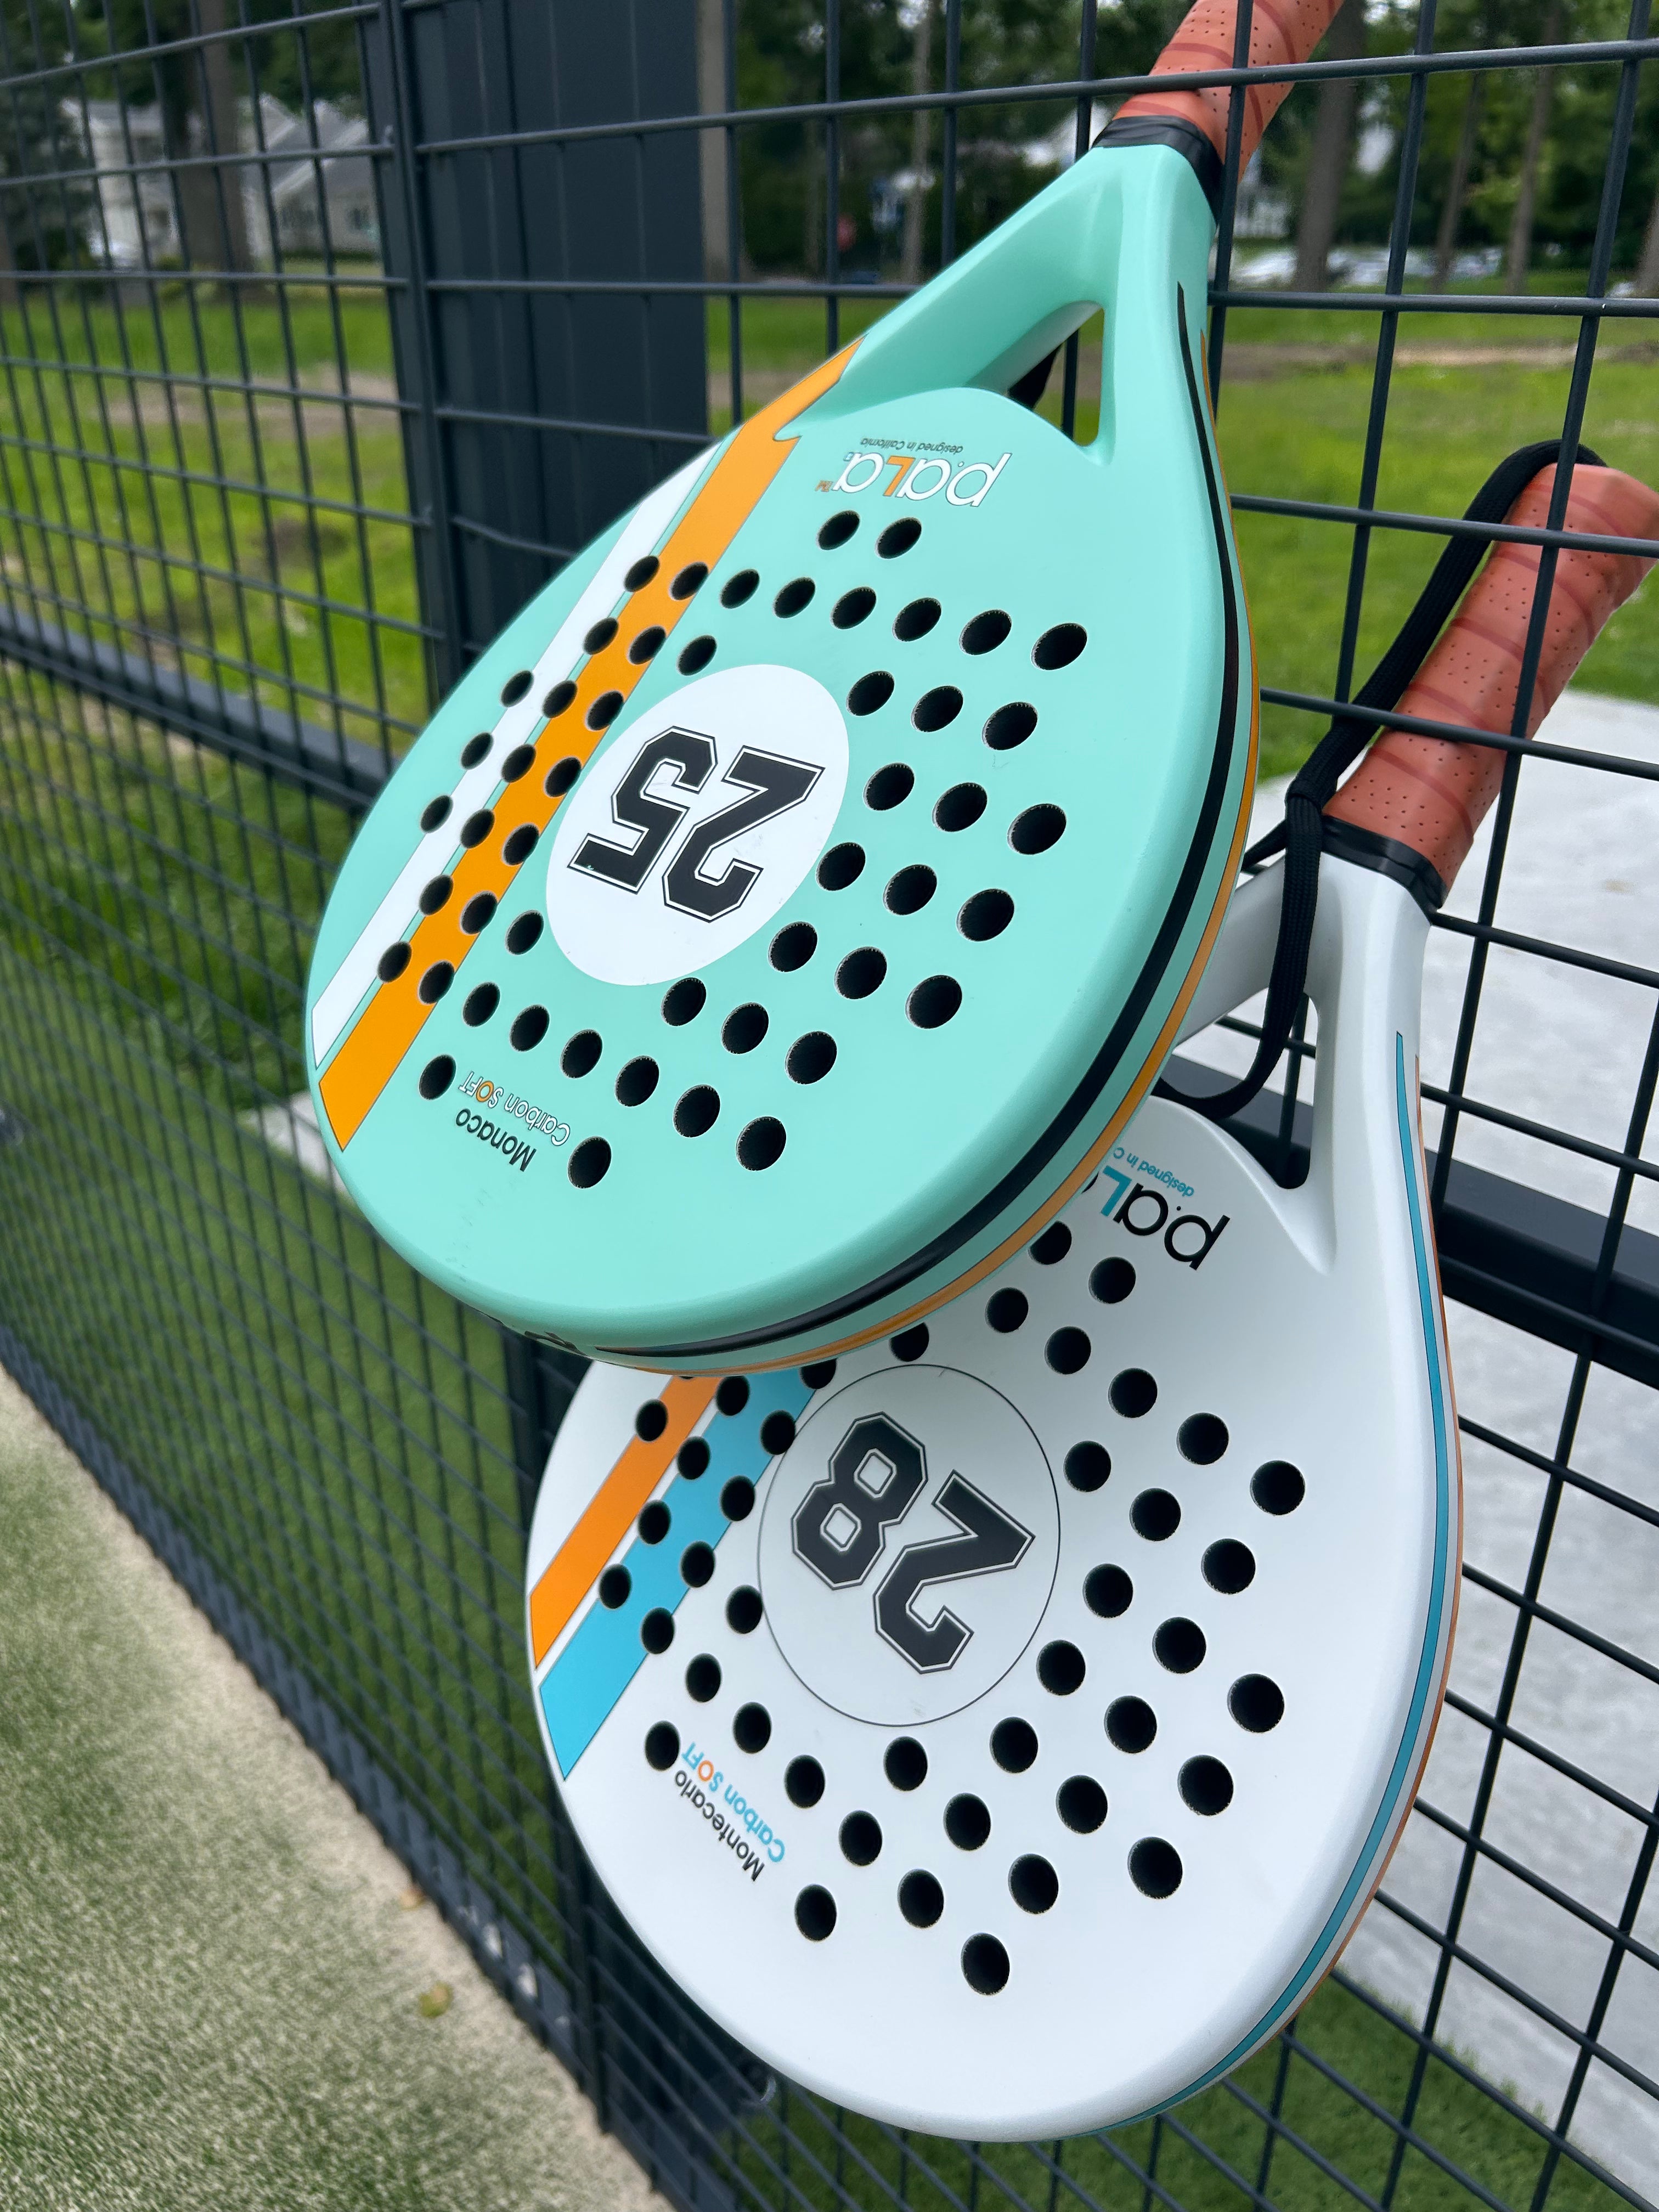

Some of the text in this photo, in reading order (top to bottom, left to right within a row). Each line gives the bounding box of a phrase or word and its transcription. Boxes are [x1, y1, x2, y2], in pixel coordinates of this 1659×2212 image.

[860, 438, 963, 454] designed in California
[567, 726, 826, 923] 25
[456, 1109, 537, 1172] Monaco
[459, 1071, 571, 1147] Carbon SOFT
[1127, 1153, 1139, 1169] in
[1137, 1160, 1194, 1198] designed
[1081, 1165, 1231, 1271] p.aL
[791, 1411, 1036, 1674] 28
[675, 1770, 765, 1882] Montecarlo
[681, 1742, 785, 1863] Carbon SOFT
